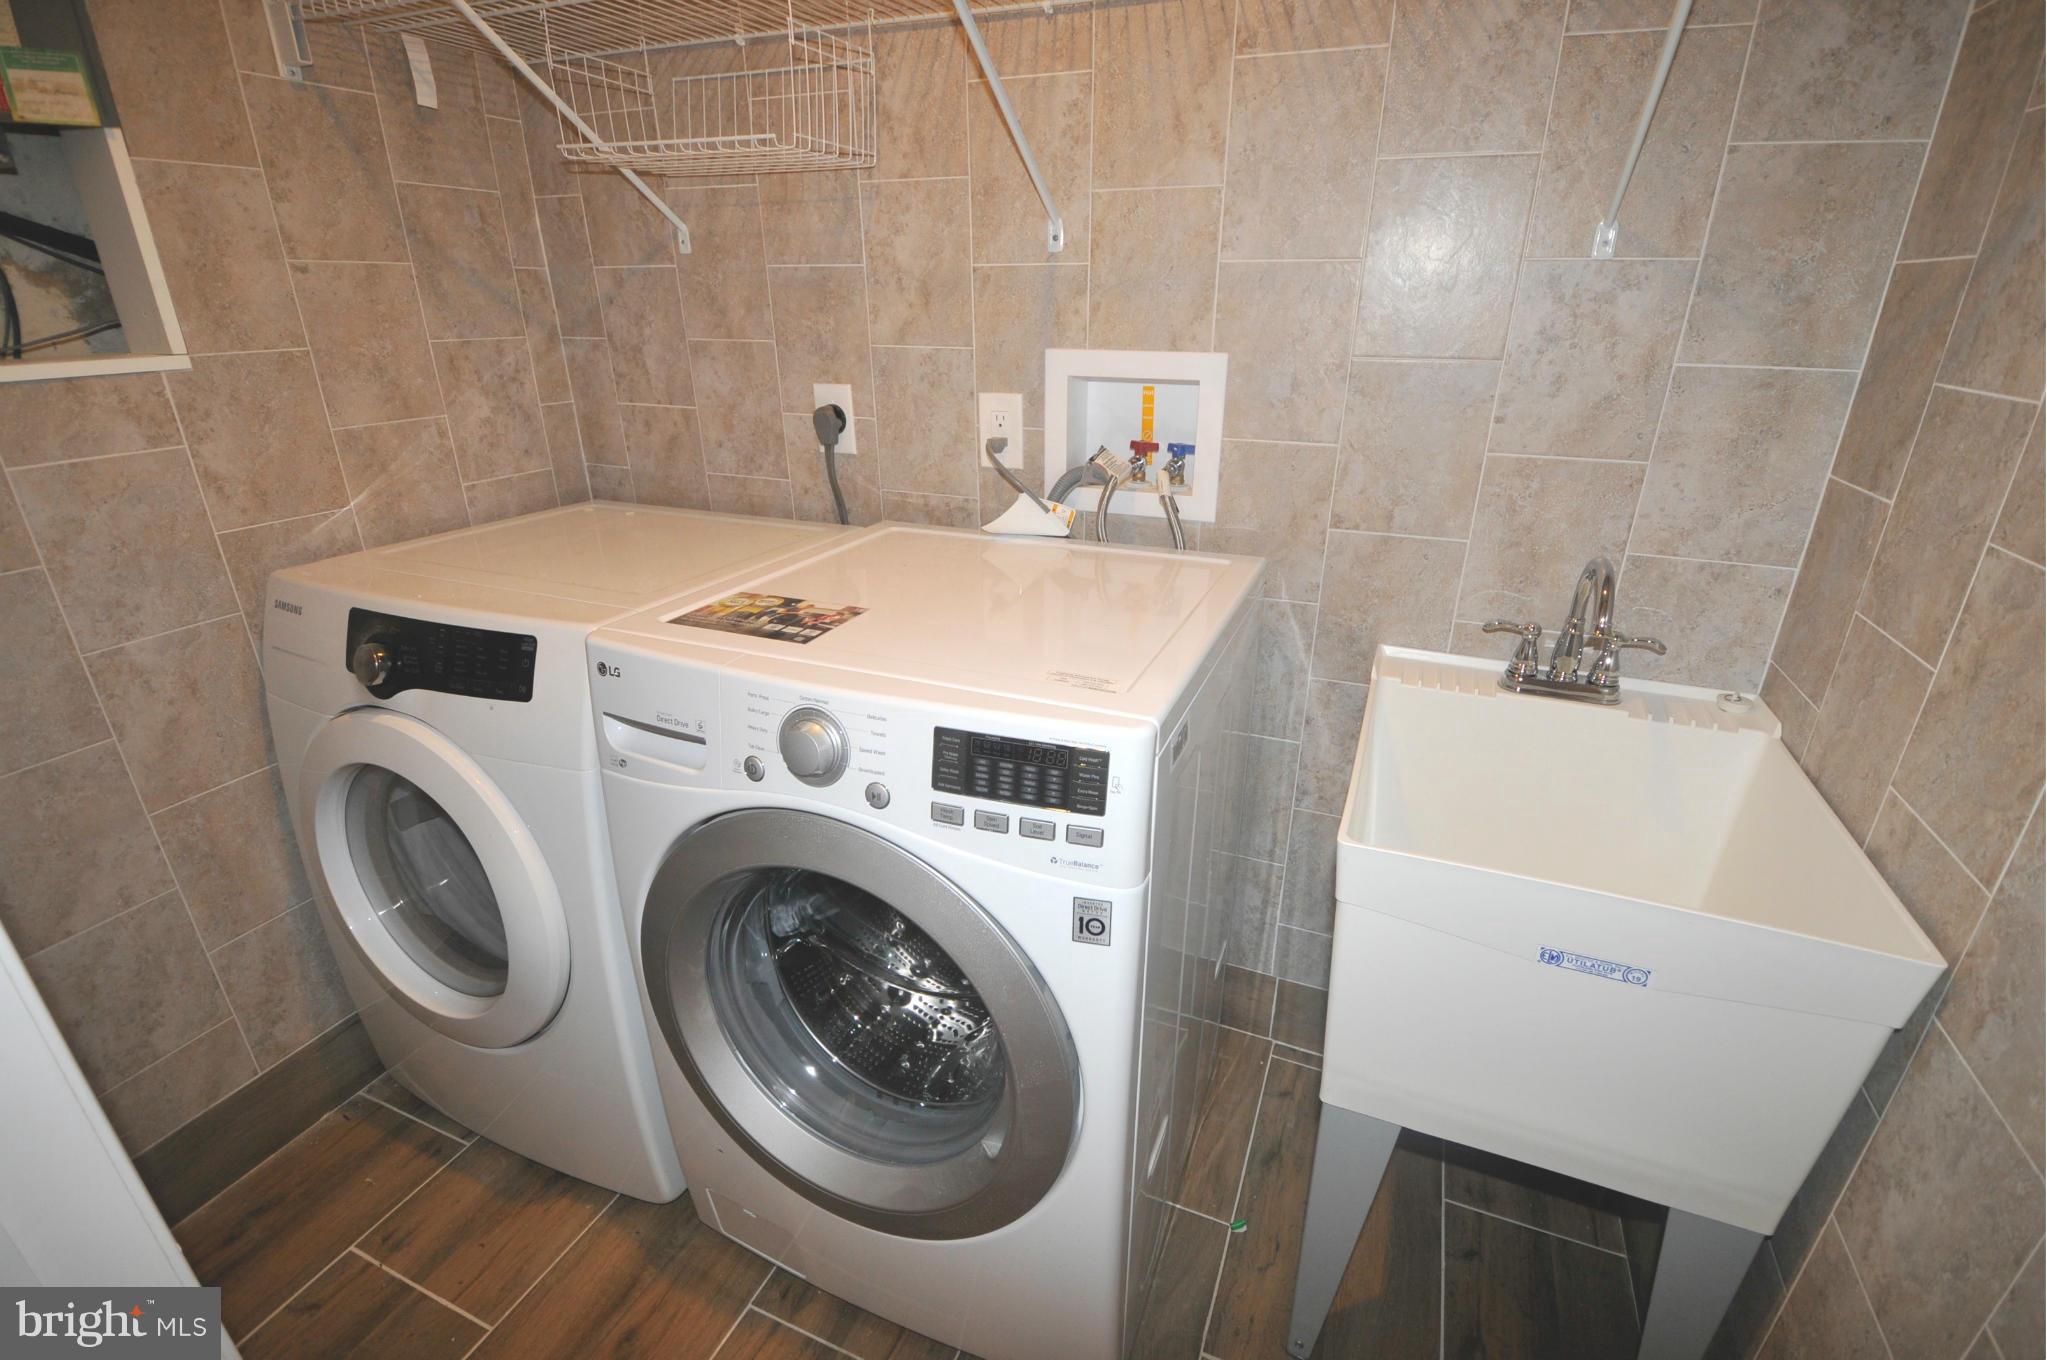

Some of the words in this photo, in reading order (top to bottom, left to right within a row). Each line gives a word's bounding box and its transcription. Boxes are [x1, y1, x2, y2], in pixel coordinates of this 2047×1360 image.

[274, 599, 303, 616] SAMSUNG
[608, 665, 621, 678] LG
[656, 714, 673, 725] Direct
[674, 718, 689, 729] Drive
[1078, 916, 1106, 936] 10
